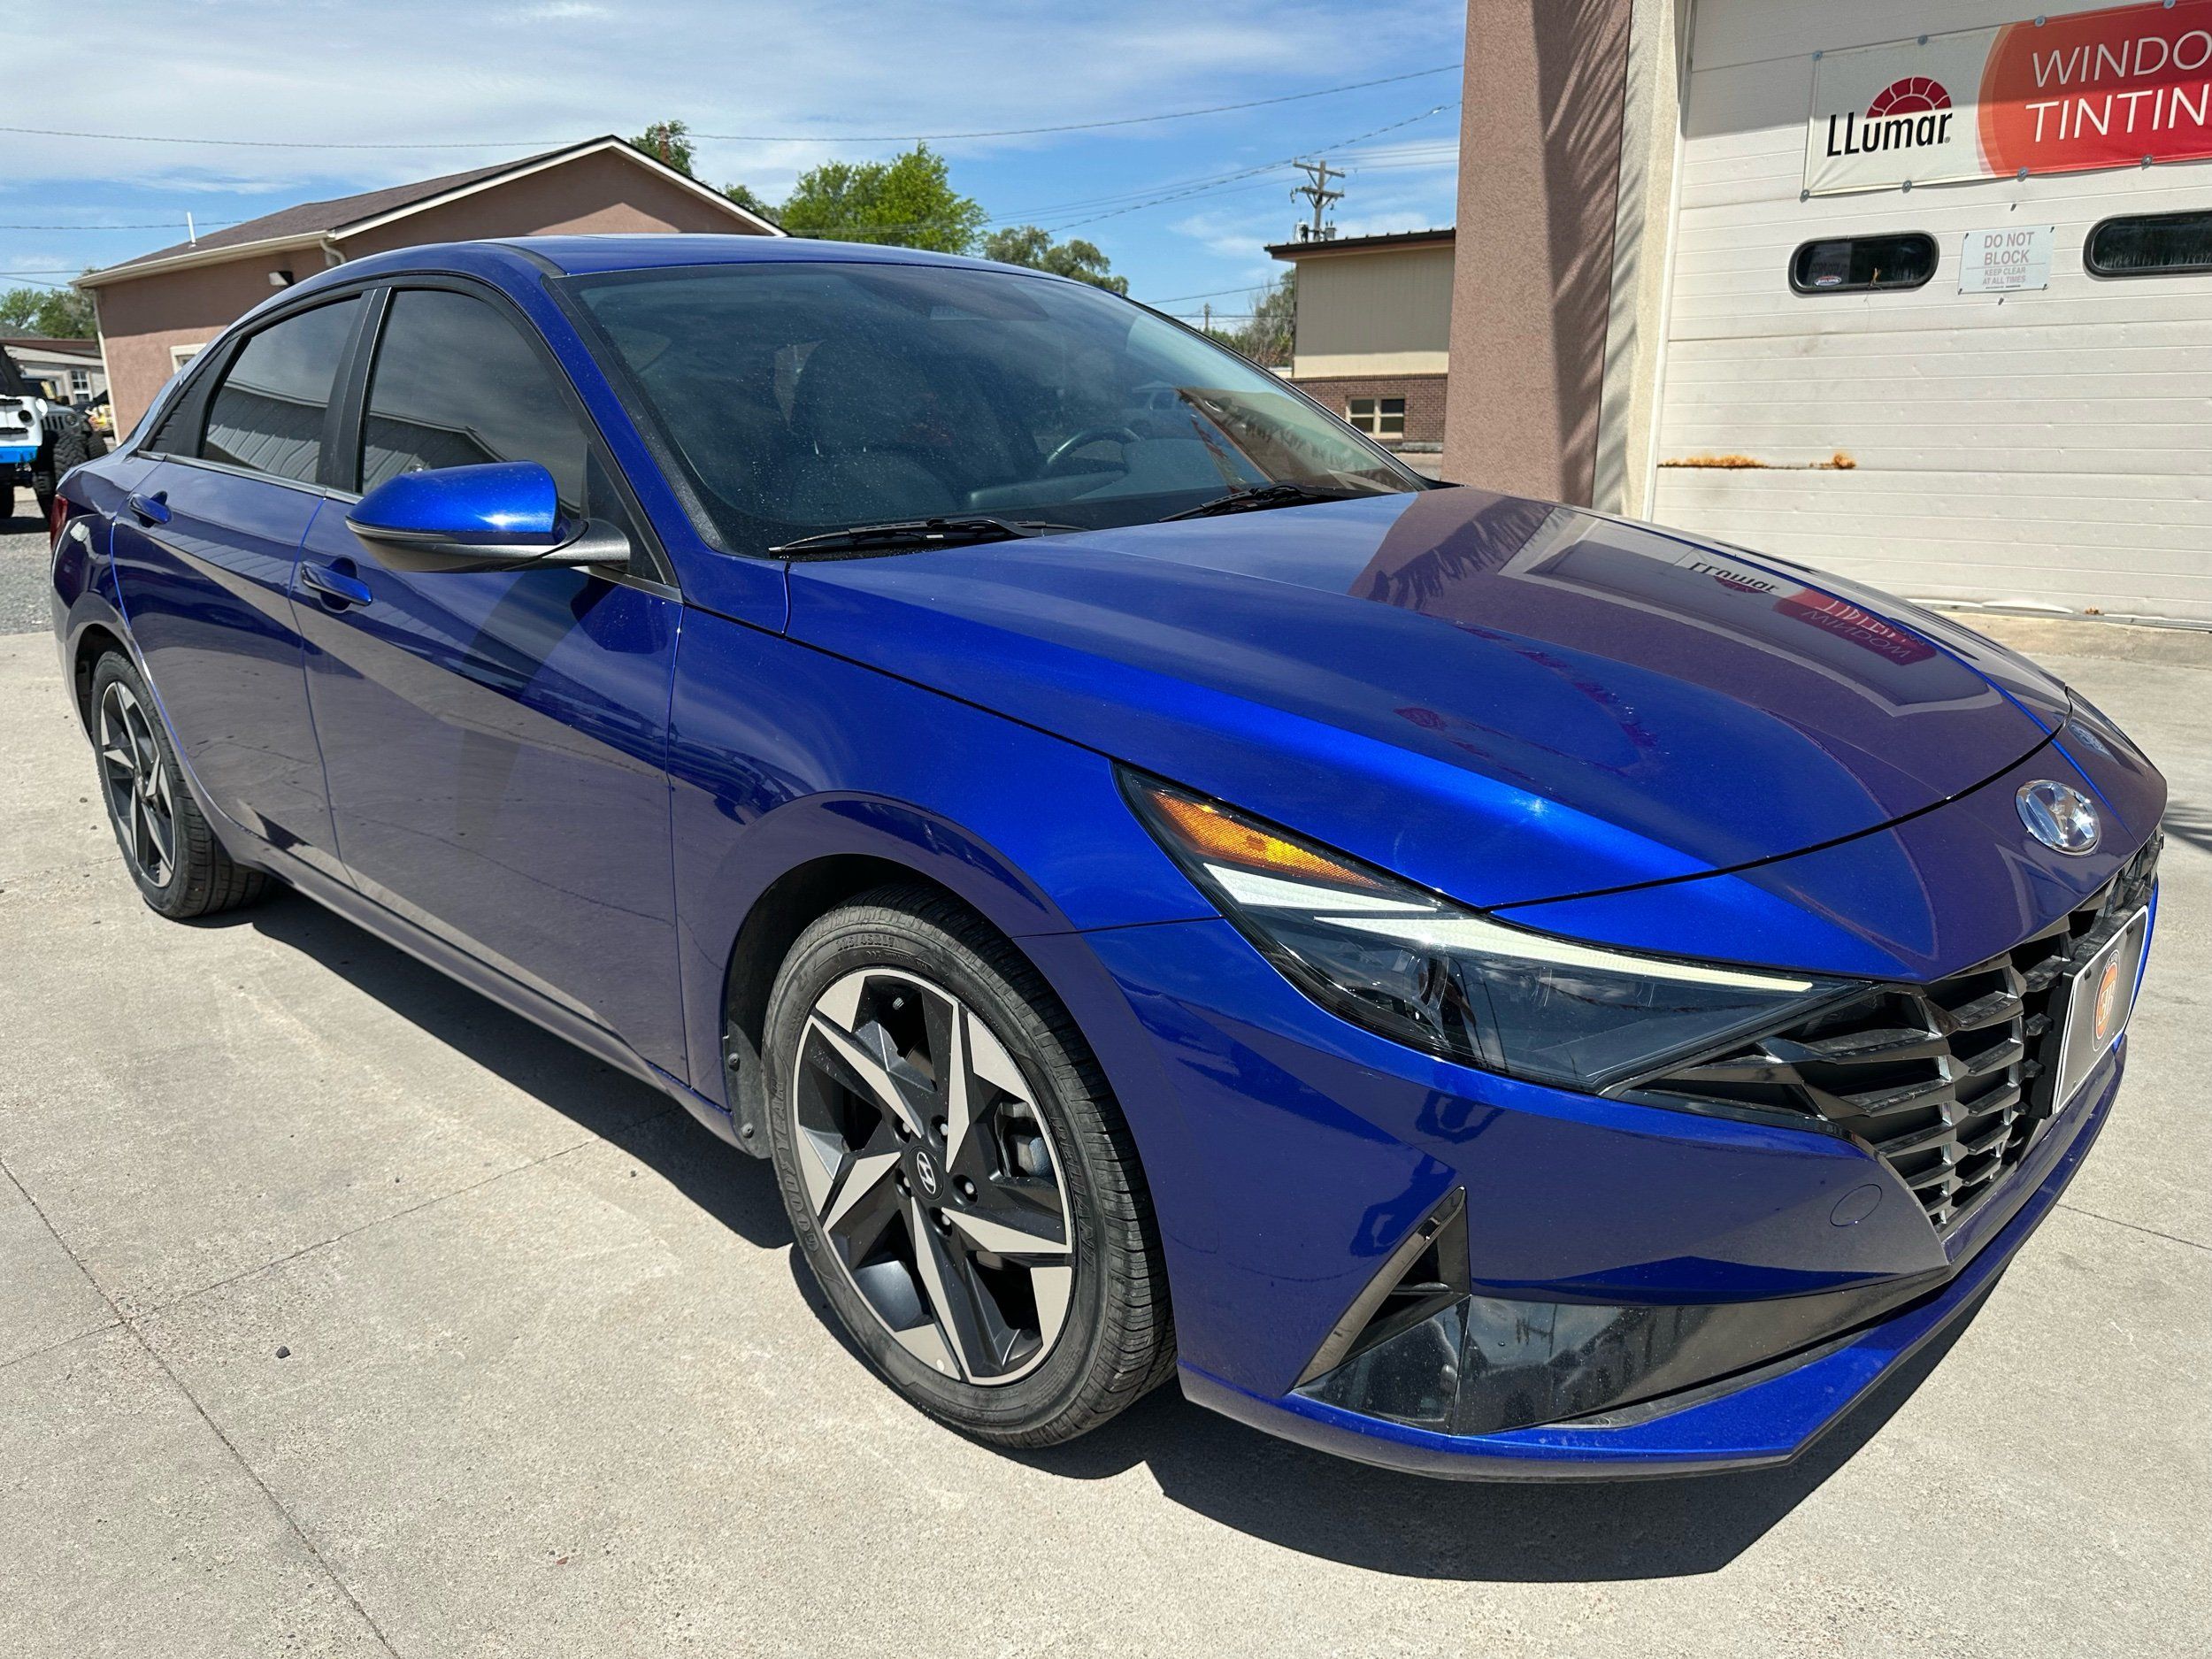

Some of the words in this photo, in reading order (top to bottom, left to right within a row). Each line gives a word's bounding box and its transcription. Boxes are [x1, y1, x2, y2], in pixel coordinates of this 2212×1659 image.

[2033, 30, 2212, 88] WINDO
[2025, 83, 2210, 142] TINTIN
[1827, 111, 1953, 157] LLumar
[1984, 234, 2003, 249] DO
[2006, 231, 2035, 247] NOT
[1984, 250, 2030, 265] BLOCK
[2002, 266, 2026, 275] CLEAR
